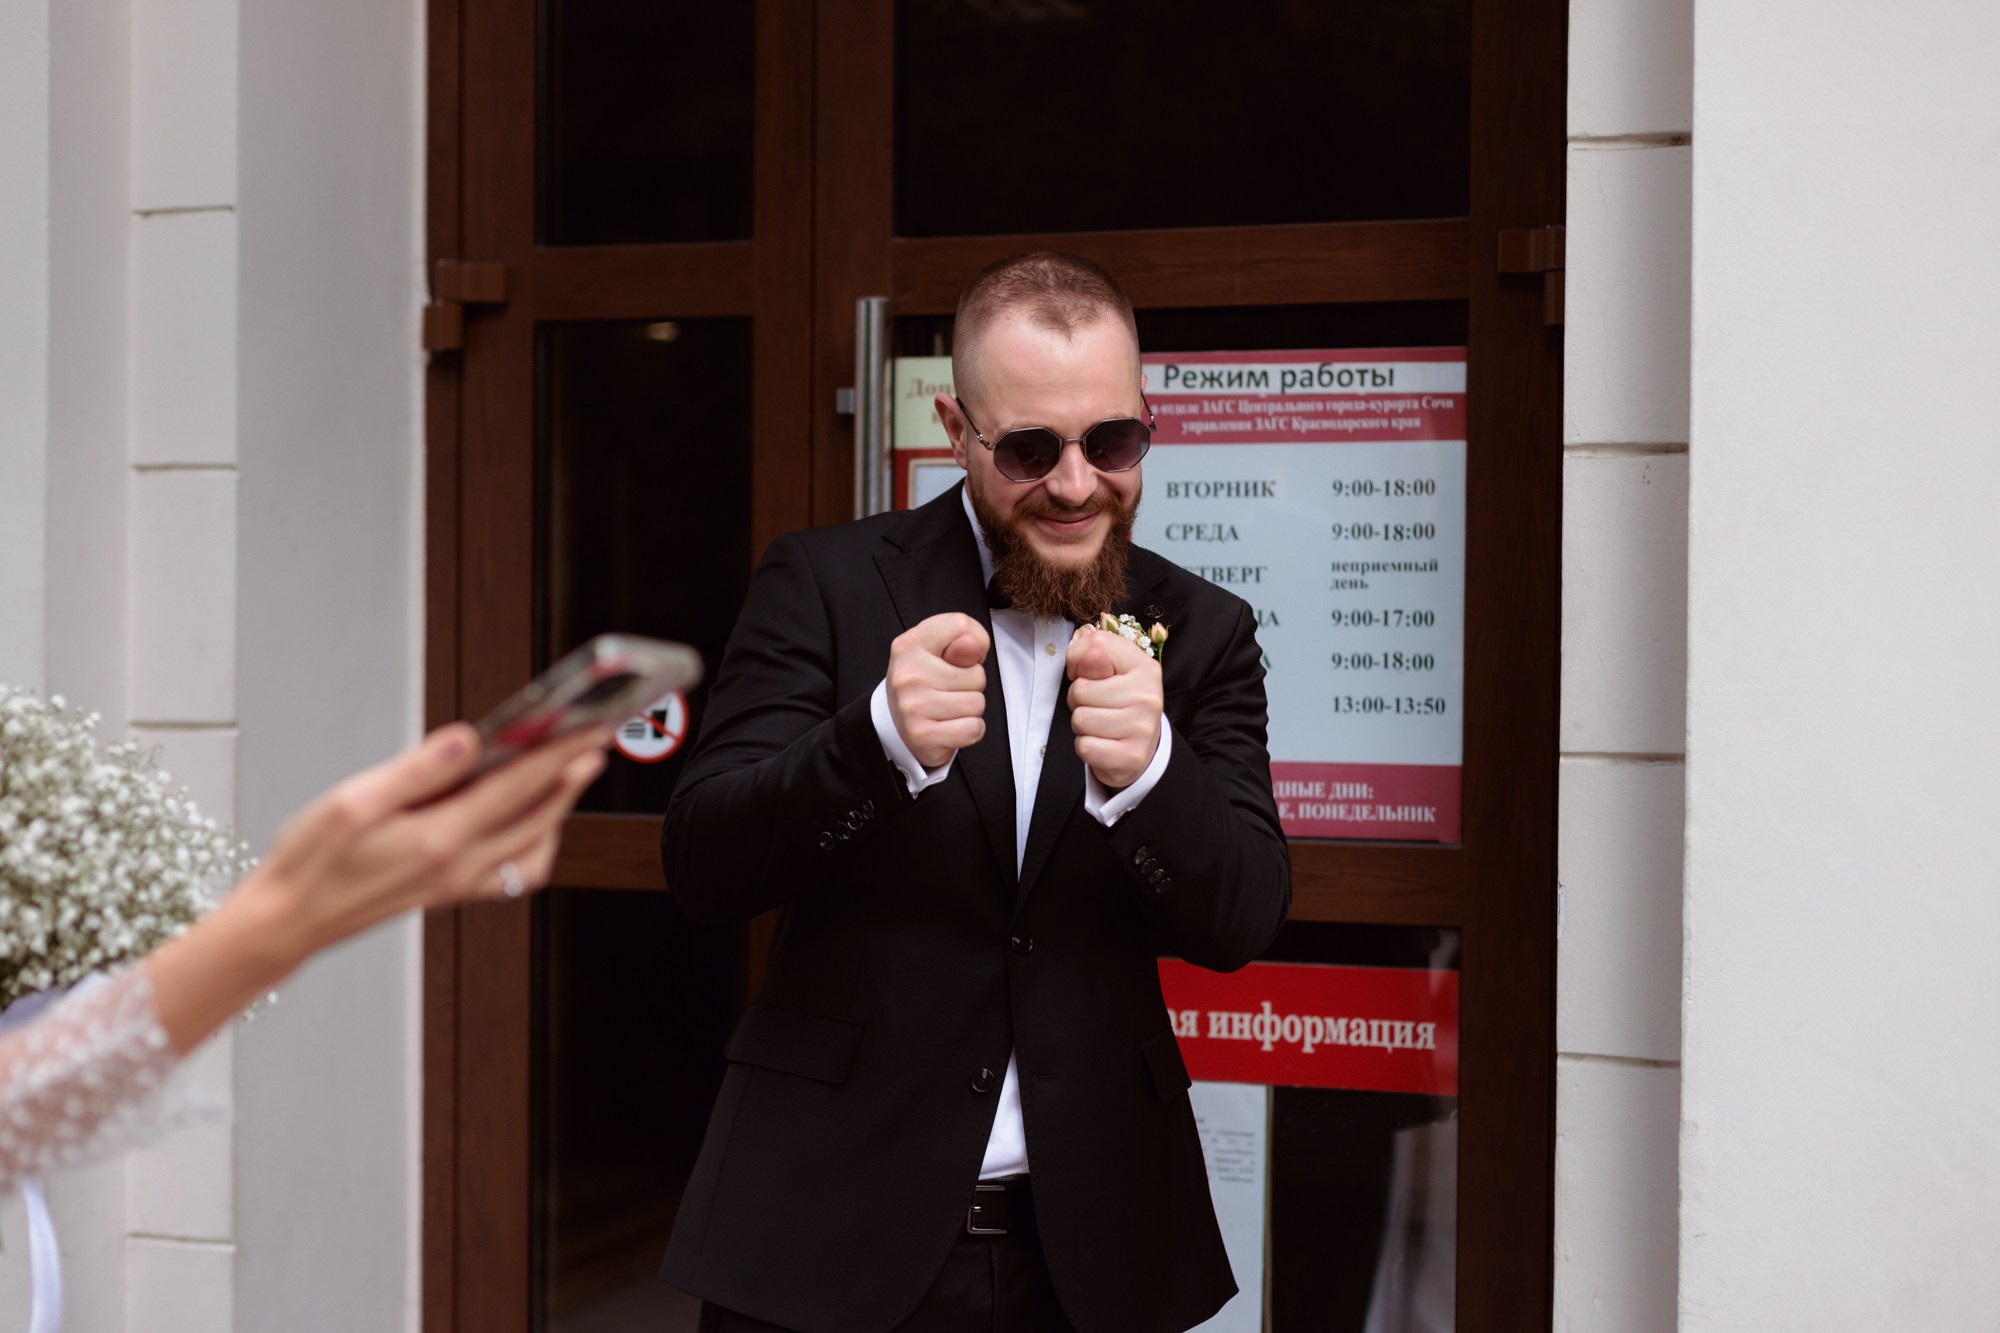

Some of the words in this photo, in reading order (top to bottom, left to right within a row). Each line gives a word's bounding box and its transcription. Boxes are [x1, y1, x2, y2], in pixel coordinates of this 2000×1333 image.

[1163, 365, 1269, 389] Режим
[1280, 363, 1394, 393] работы
[1160, 403, 1199, 415] отделе
[1202, 400, 1235, 414] ЗАГС
[1238, 399, 1323, 416] Центрального
[1326, 398, 1419, 415] города-курорта
[1421, 396, 1454, 410] Сочи
[1182, 420, 1252, 435] управления
[1255, 418, 1288, 432] ЗАГС
[1292, 417, 1388, 434] Краснодарского
[1391, 417, 1421, 432] края
[1165, 481, 1276, 498] ВТОРНИК
[1332, 479, 1436, 497] 9:00-18:00
[1165, 524, 1240, 543] СРЕДА
[1331, 523, 1436, 541] 9:00-18:00
[1186, 566, 1268, 584] ТВЕРГ
[1331, 559, 1439, 574] неприемный
[1330, 577, 1369, 590] день
[1331, 609, 1435, 627] 9:00-17:00
[1331, 652, 1435, 671] 9:00-18:00
[1332, 696, 1446, 715] 13:00-13:50
[1273, 781, 1326, 798] ДНЫЕ
[1329, 782, 1374, 800] ДНИ:
[1298, 803, 1436, 823] ПОНЕДЕЛЬНИК
[1207, 1001, 1436, 1053] информация
